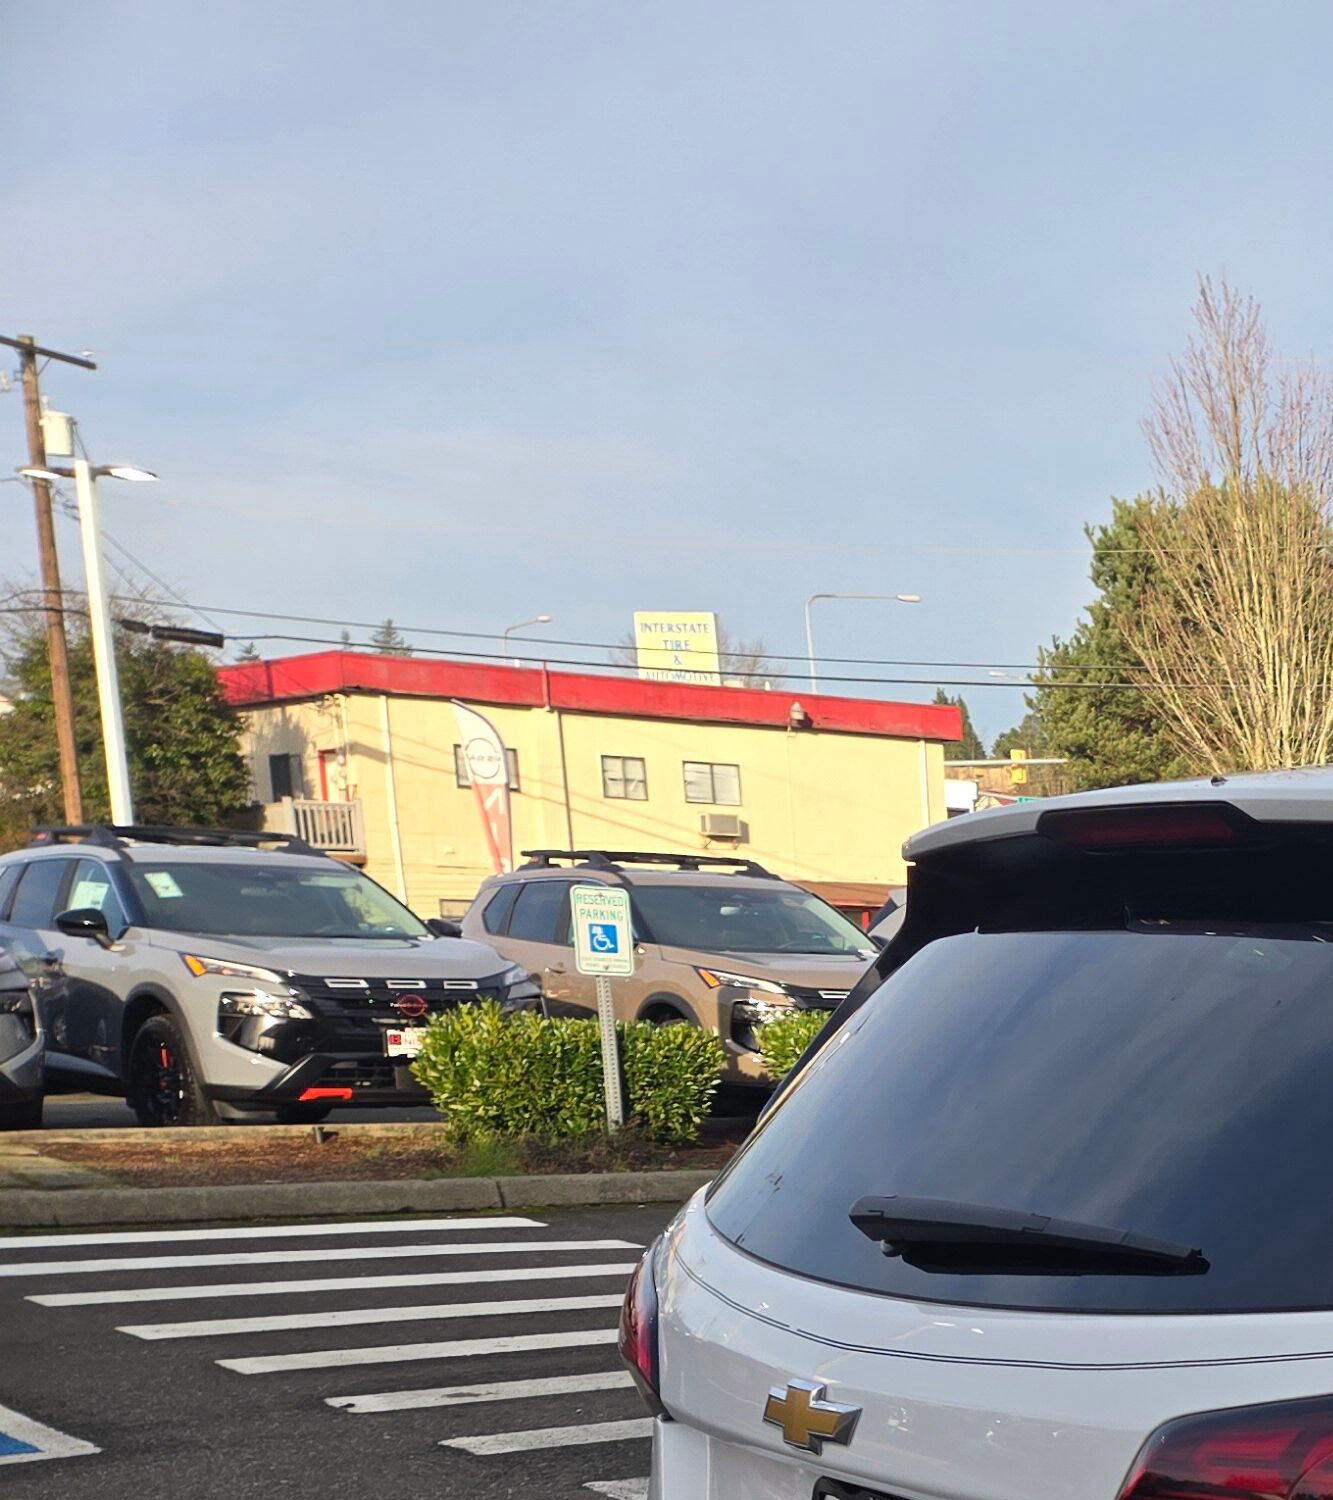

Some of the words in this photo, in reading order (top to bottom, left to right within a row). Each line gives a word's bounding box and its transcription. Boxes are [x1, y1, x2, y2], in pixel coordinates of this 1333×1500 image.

[640, 623, 710, 633] INTERSTATE
[663, 640, 690, 650] TIRE
[674, 655, 682, 665] &
[576, 894, 623, 906] RESERVED
[580, 908, 624, 921] PARKING
